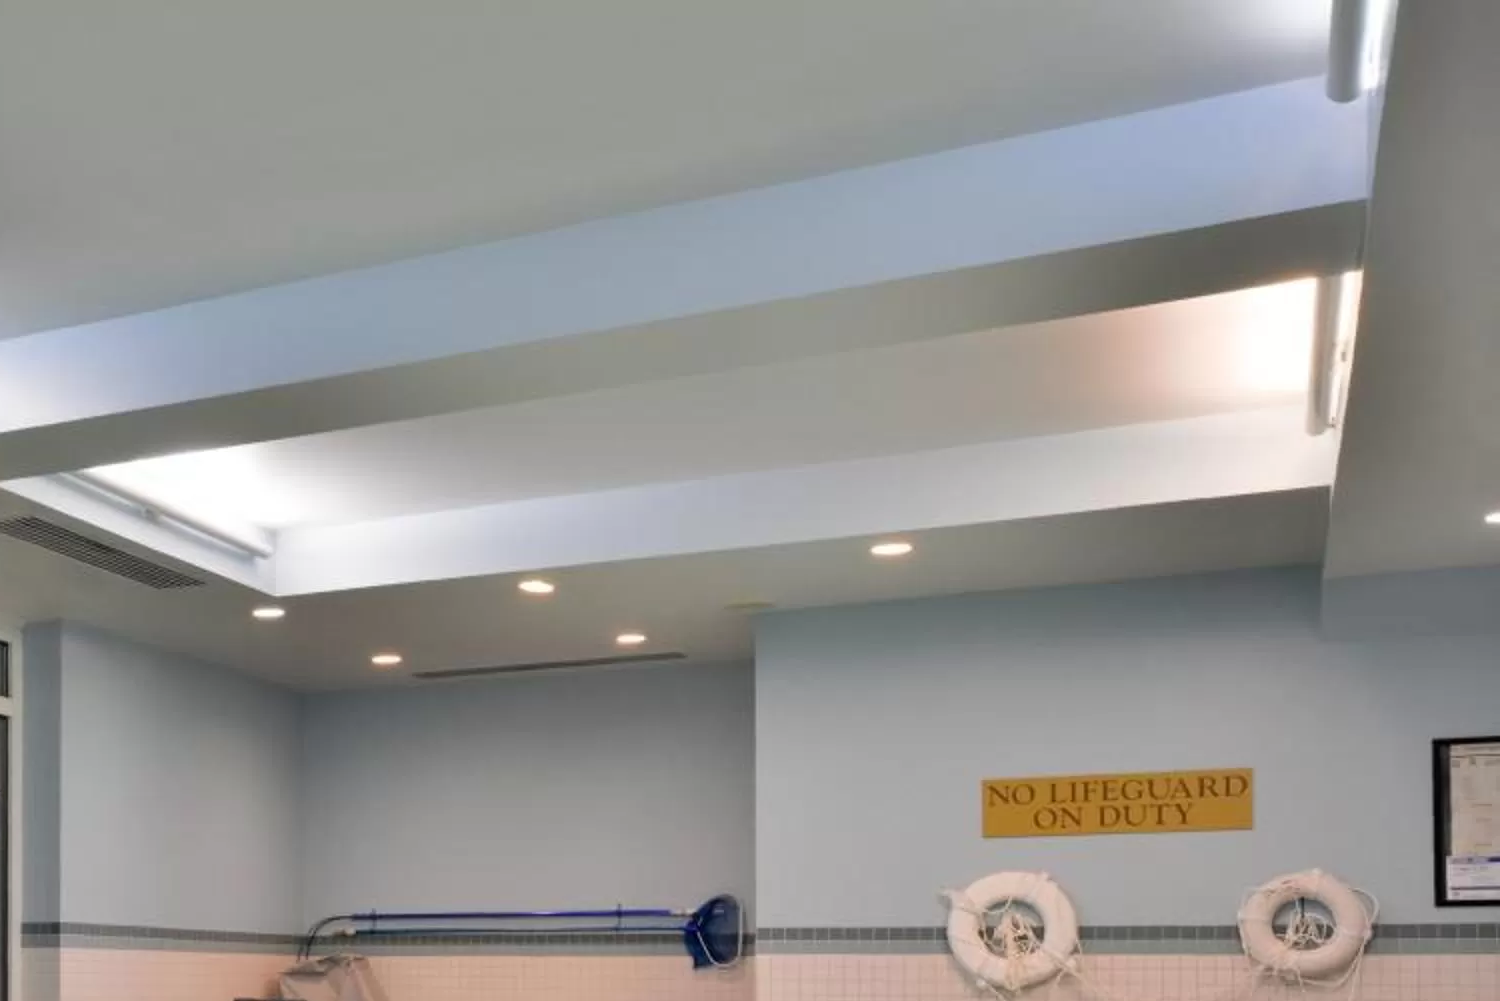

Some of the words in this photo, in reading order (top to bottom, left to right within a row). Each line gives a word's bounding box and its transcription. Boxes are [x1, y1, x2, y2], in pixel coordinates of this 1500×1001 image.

[987, 783, 1036, 808] NO
[1048, 775, 1249, 804] LIFEGUARD
[1032, 805, 1083, 830] ON
[1098, 801, 1195, 828] DUTY
